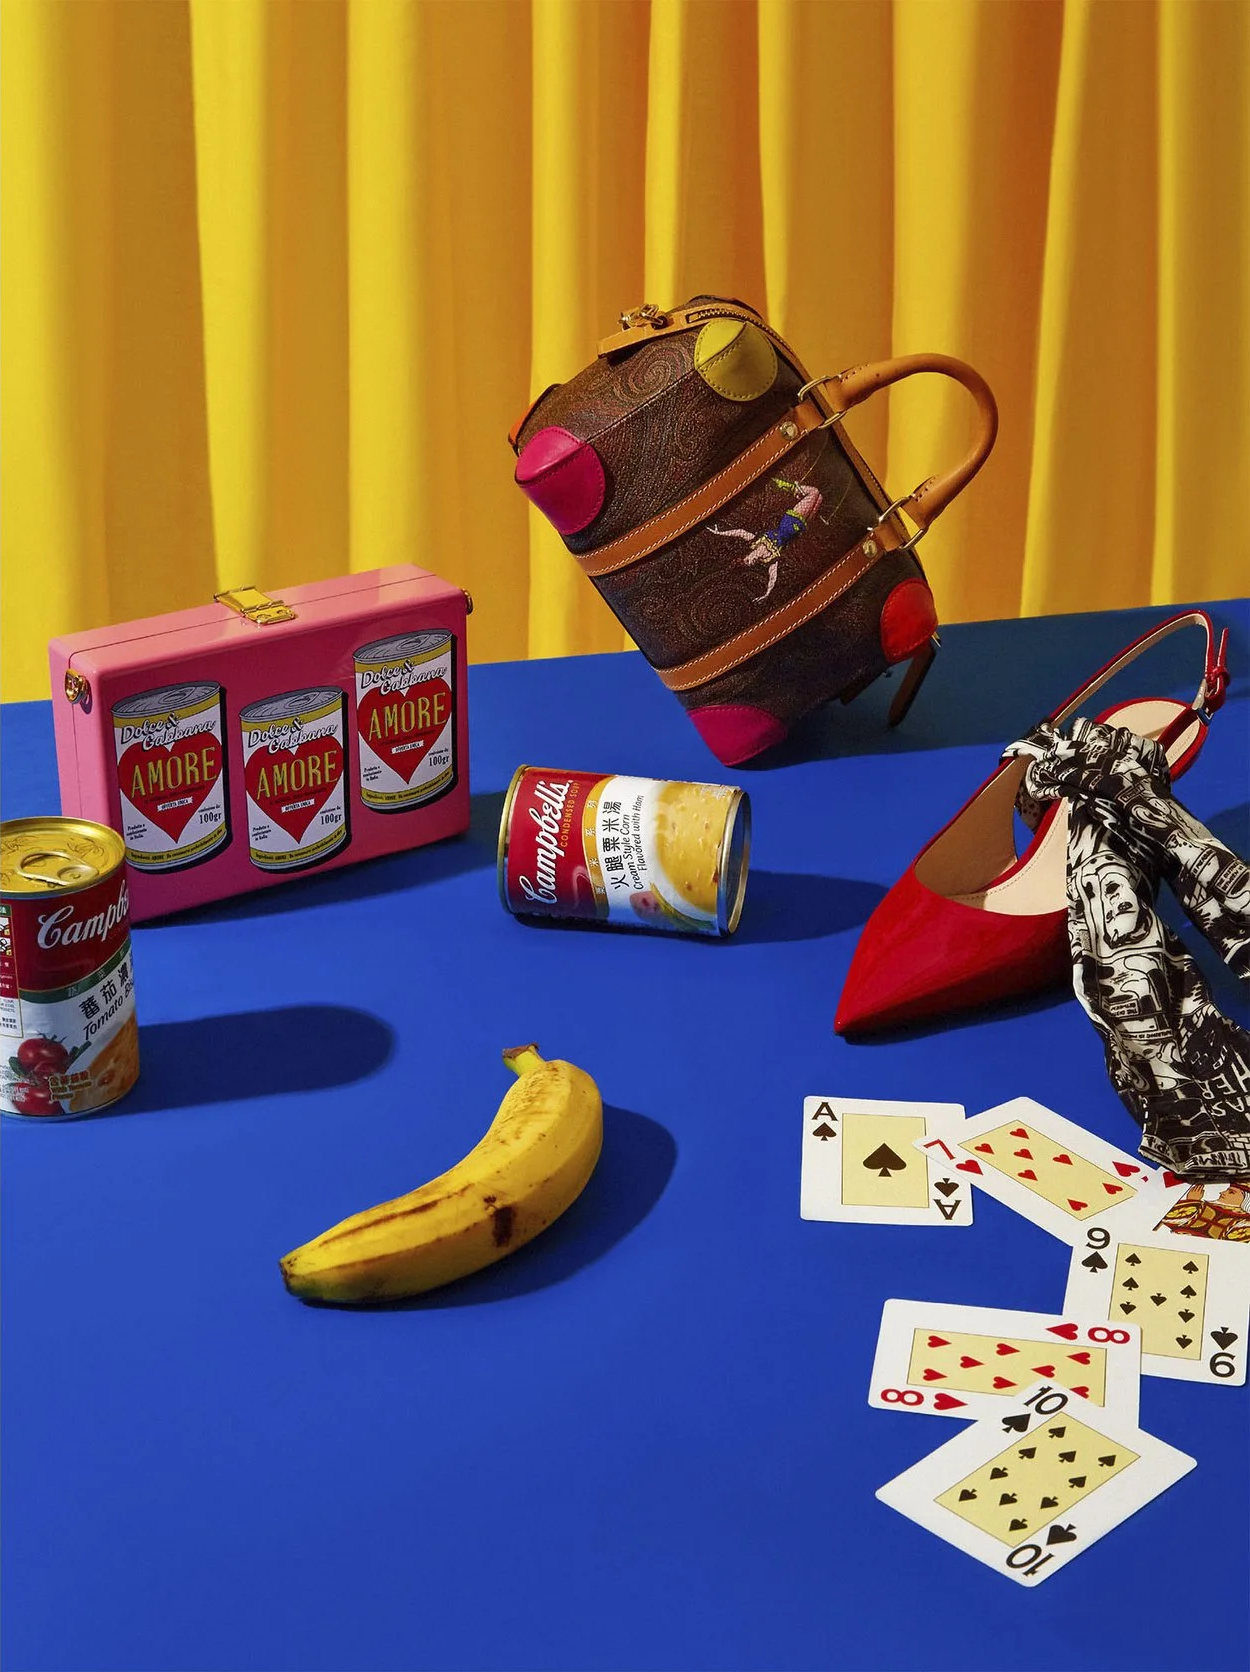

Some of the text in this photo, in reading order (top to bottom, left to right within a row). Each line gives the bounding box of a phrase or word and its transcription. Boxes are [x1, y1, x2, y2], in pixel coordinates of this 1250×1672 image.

[361, 658, 415, 689] Dolce &
[379, 667, 448, 695] Gabbana
[121, 712, 180, 744] Dolce &
[248, 716, 304, 748] Dolce &
[368, 692, 446, 741] AMORE
[142, 720, 217, 752] Gabbana
[268, 724, 338, 755] Gabbana
[131, 747, 217, 798] AMORE
[257, 750, 338, 800] AMORE
[429, 755, 450, 767] 100gr
[199, 812, 222, 825] 100gr
[320, 813, 343, 826] 100gr
[559, 799, 576, 848] CONDENSED
[632, 811, 641, 831] with
[519, 780, 573, 904] Campbell's
[601, 801, 630, 890] 火腿粟米湯
[619, 814, 644, 890] Cream Style Corn
[631, 833, 648, 871] Flavored
[83, 995, 124, 1041] Tomato
[811, 1102, 839, 1121] A
[922, 1138, 956, 1160] 7
[933, 1198, 962, 1221] A
[1085, 1227, 1111, 1250] 9
[1087, 1326, 1131, 1345] 8
[1208, 1352, 1236, 1378] 9
[879, 1387, 925, 1407] 8
[1022, 1385, 1069, 1416] 10
[1005, 1543, 1056, 1577] 10
